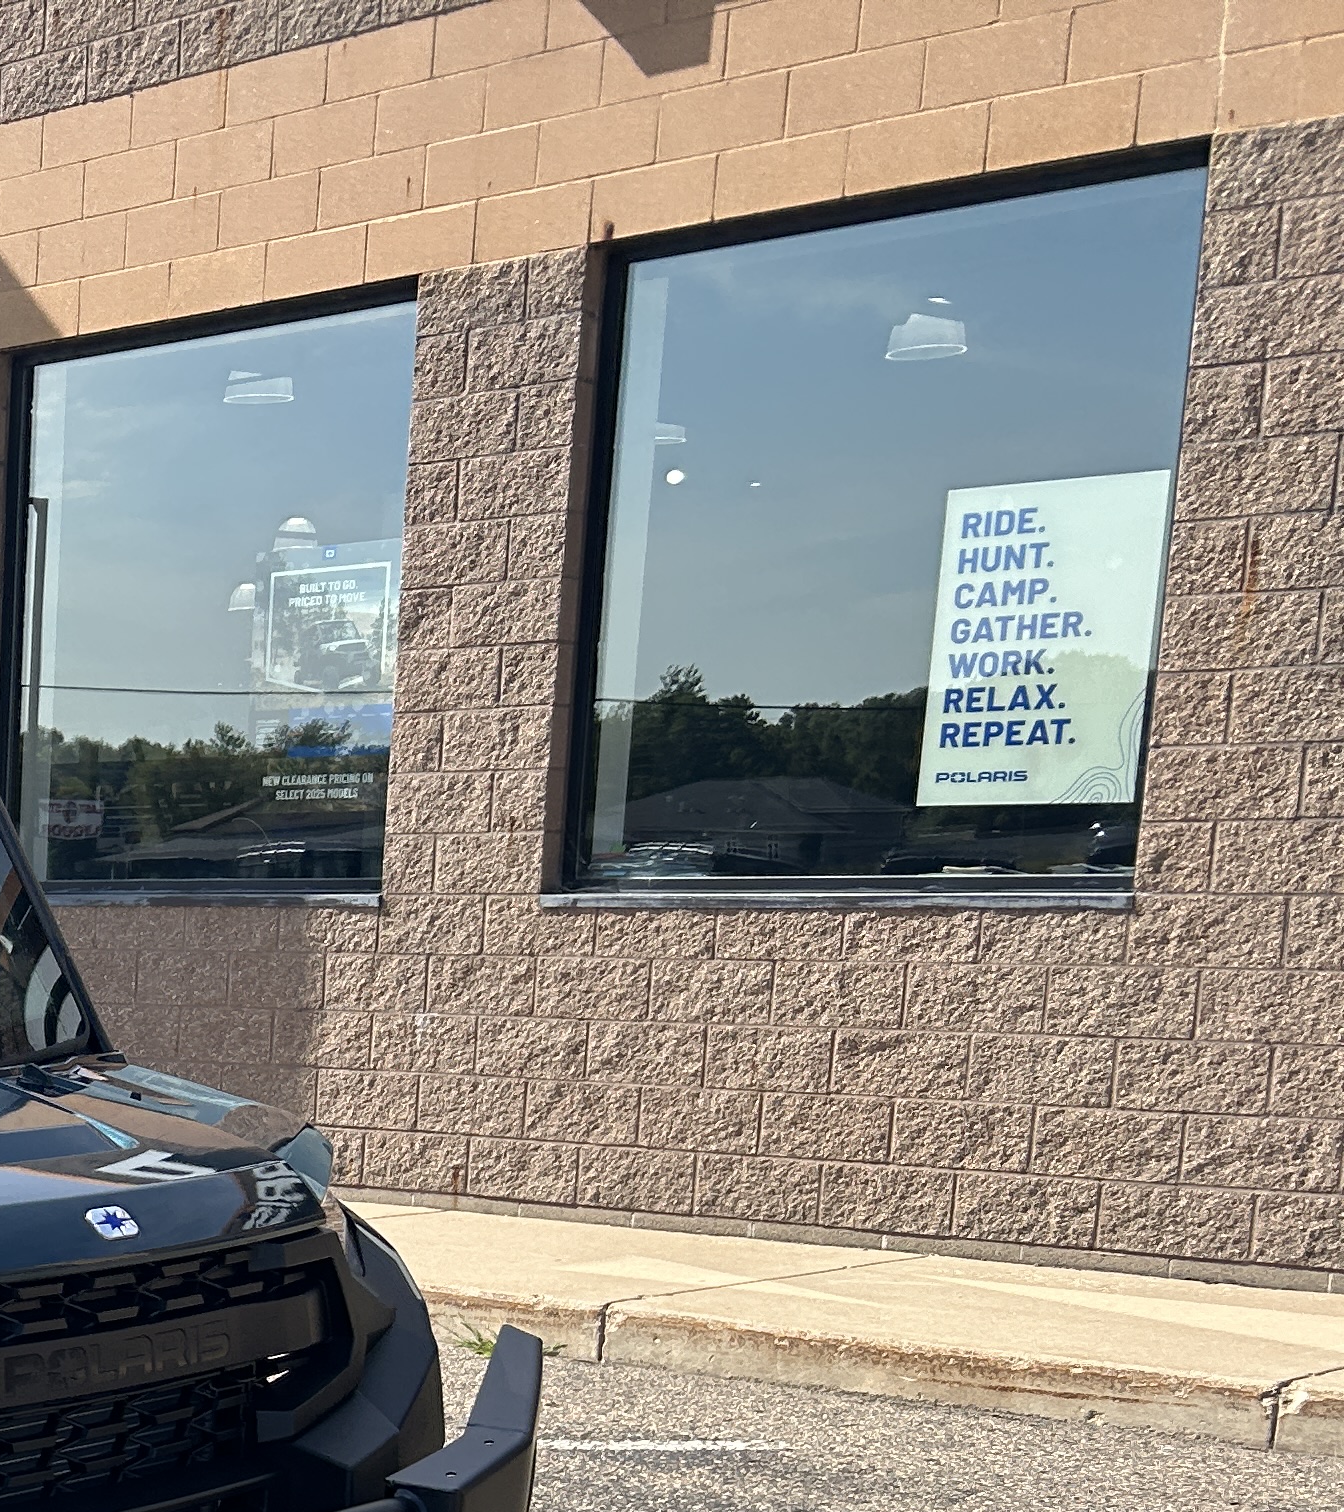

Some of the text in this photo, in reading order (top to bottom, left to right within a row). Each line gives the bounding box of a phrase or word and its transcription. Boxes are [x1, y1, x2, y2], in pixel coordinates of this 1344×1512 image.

[961, 507, 1046, 539] RIDE.
[957, 542, 1055, 574] HUNT.
[288, 591, 366, 607] PRICED TO MOVE
[299, 582, 327, 594] BUILT
[328, 580, 341, 592] TO
[954, 577, 1057, 609] CAMP.
[950, 611, 1092, 644] GATHER.
[948, 649, 1055, 679] WORK.
[942, 683, 1066, 714] RELAX.
[939, 718, 1076, 748] REPEAT.
[262, 772, 374, 787] NEW CLEARANCE PRICING ON
[935, 770, 1029, 784] POLARIS
[275, 787, 359, 801] SELECT 2025 MODELS
[3, 1319, 231, 1396] POLARIS
